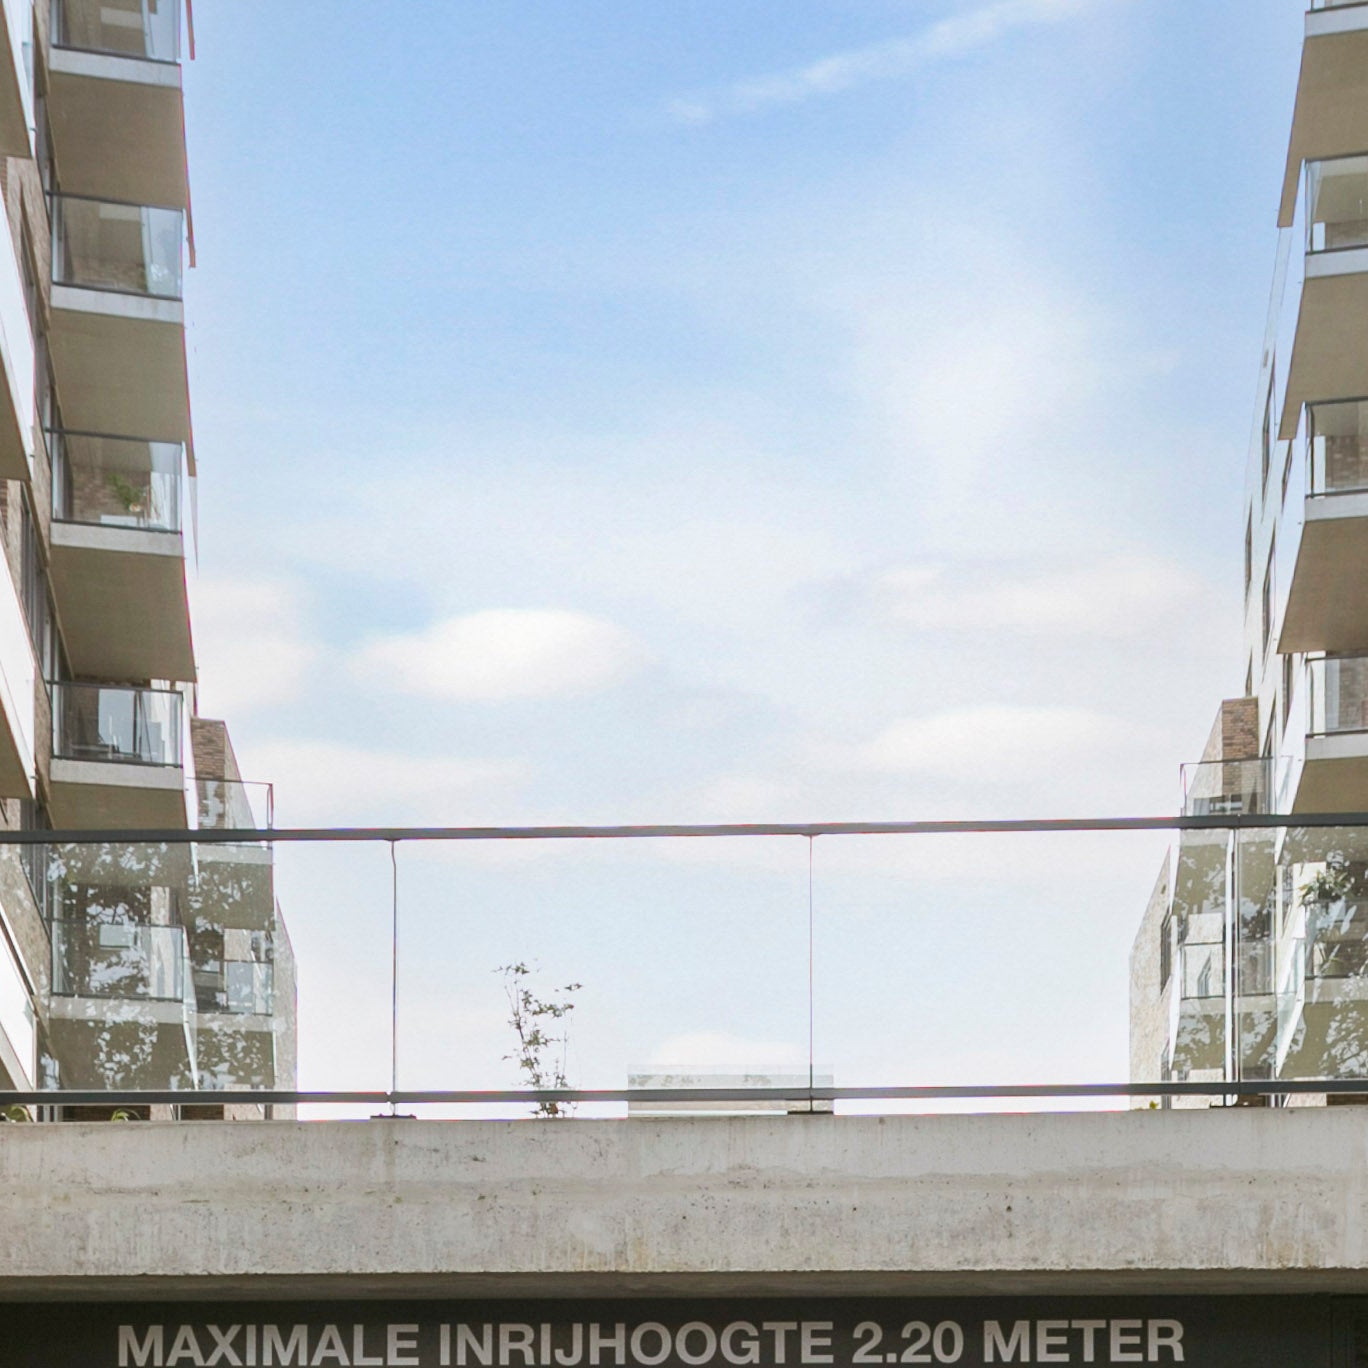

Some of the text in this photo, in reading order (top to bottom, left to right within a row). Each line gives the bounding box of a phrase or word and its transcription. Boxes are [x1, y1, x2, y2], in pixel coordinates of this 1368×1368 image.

[117, 1320, 1186, 1367] MAXIMALE INRIJHOOGTE 2.20 METER
